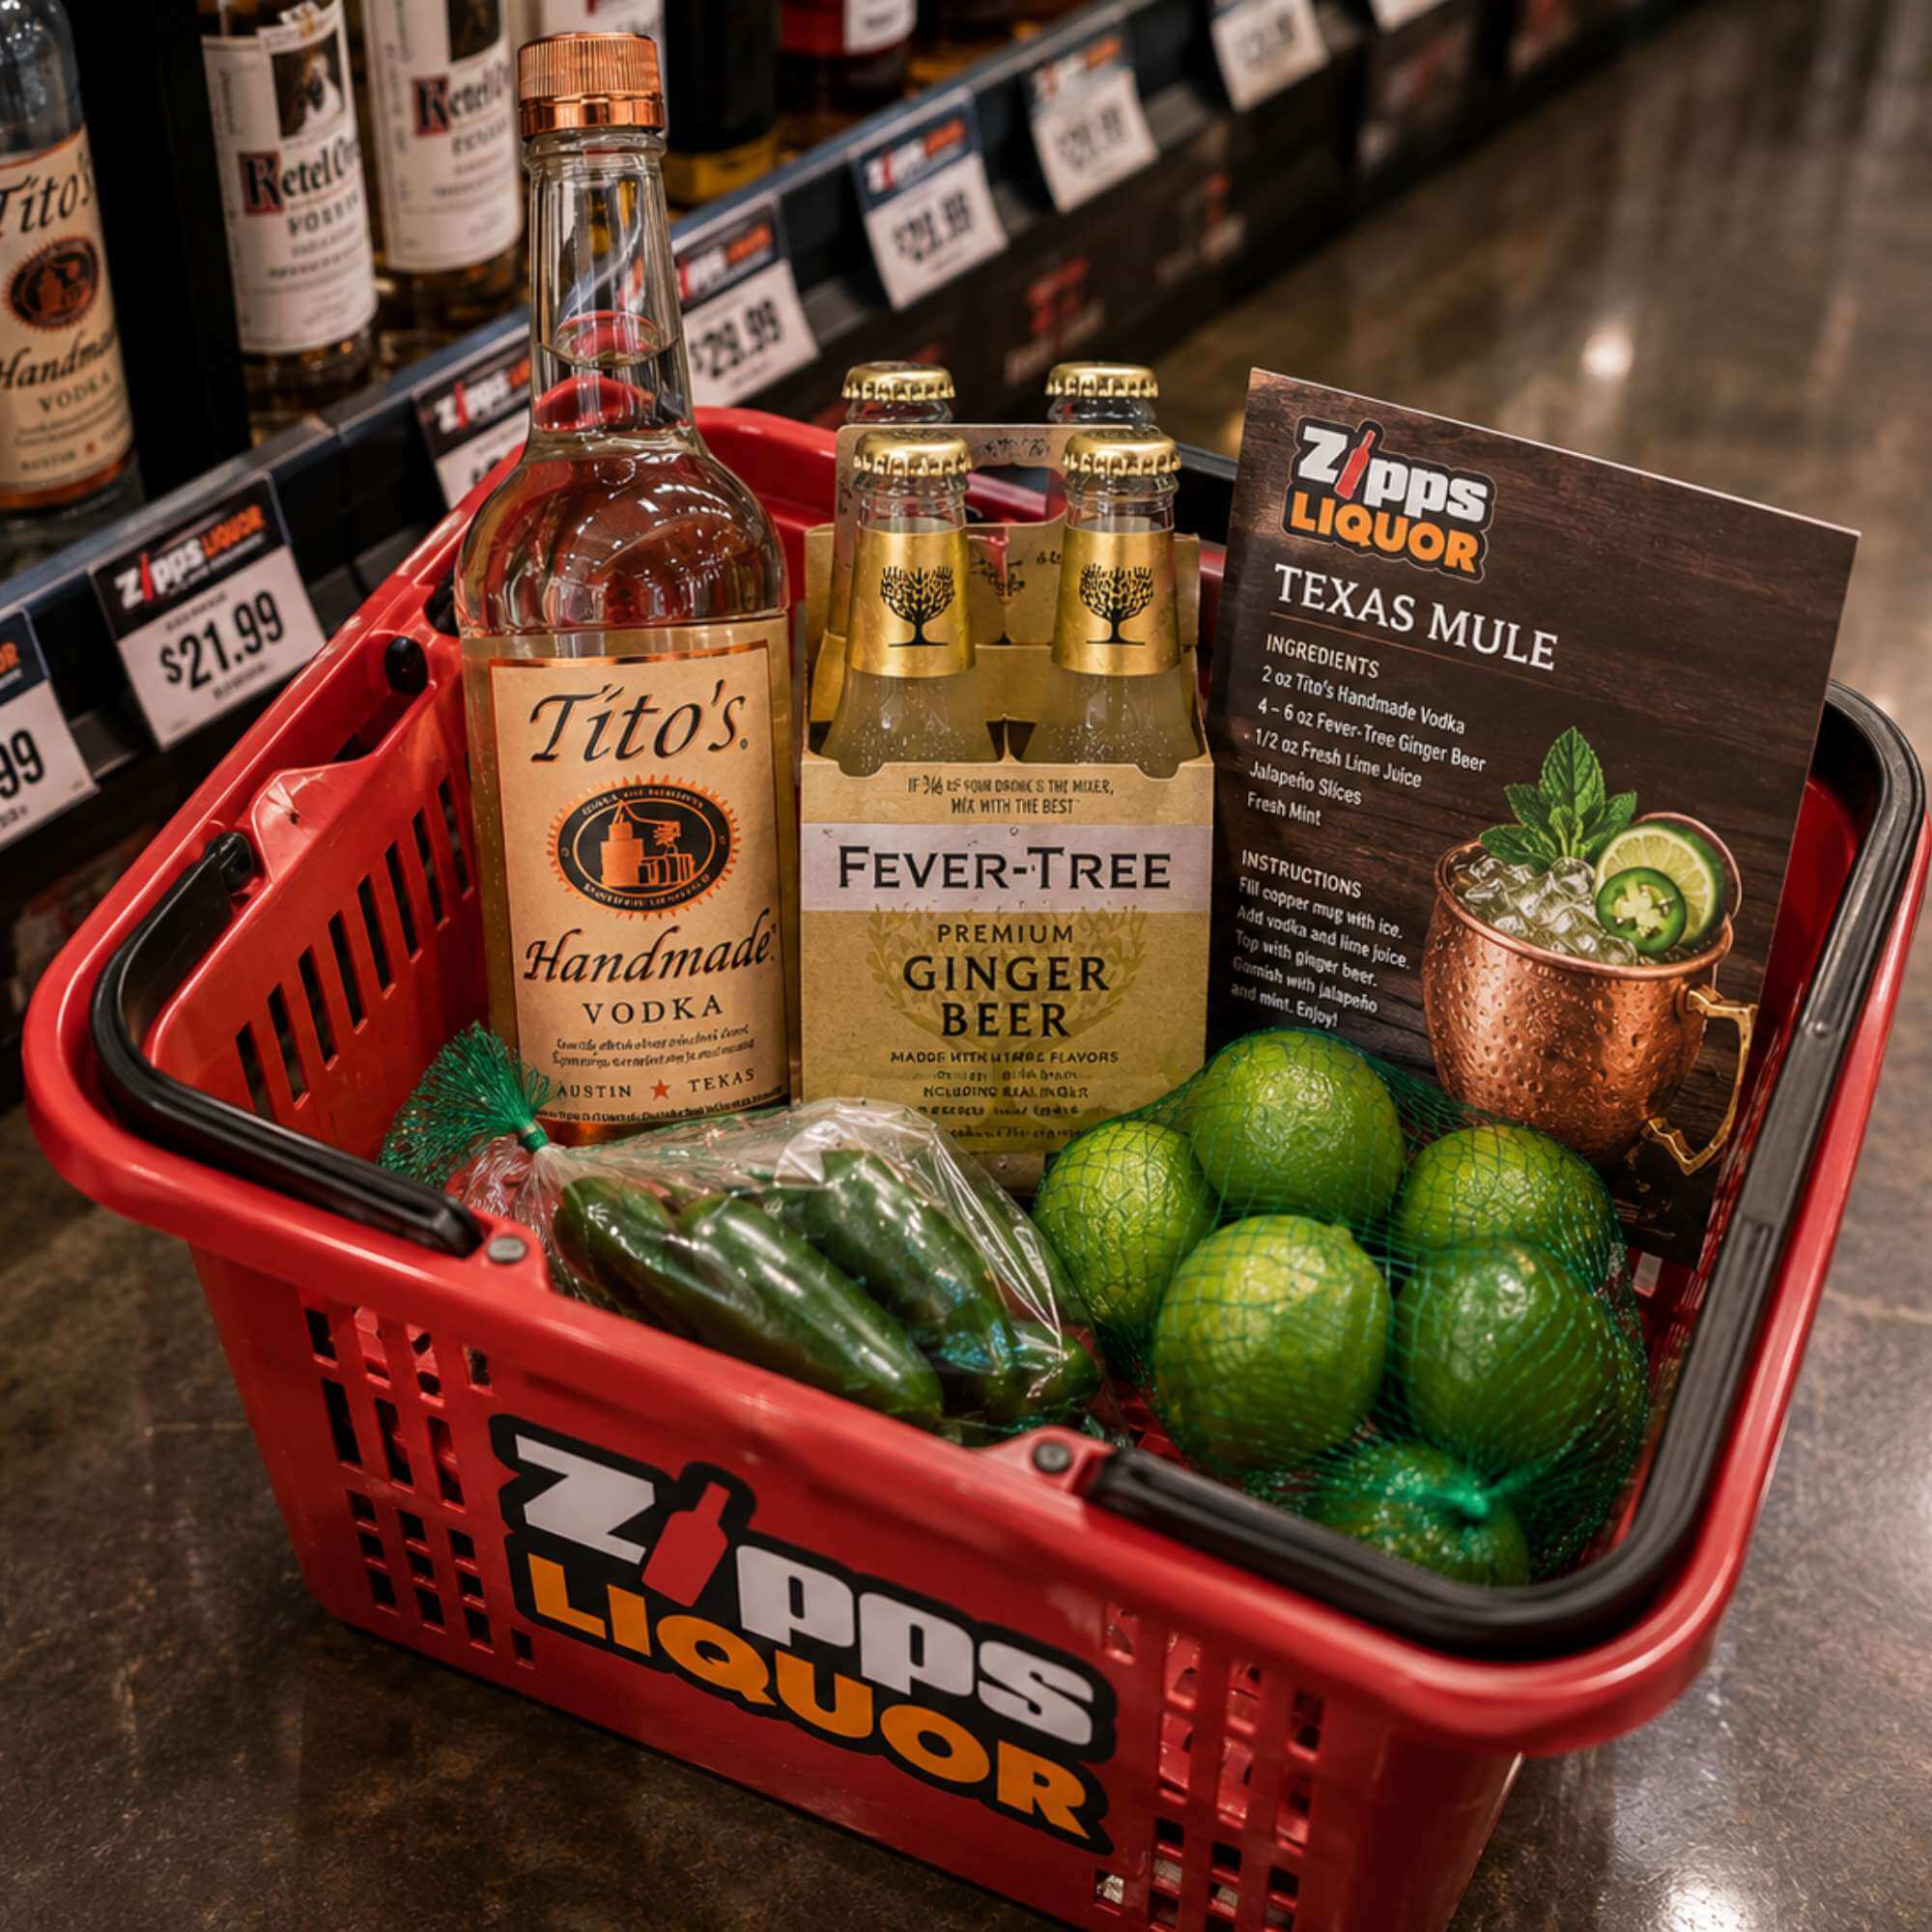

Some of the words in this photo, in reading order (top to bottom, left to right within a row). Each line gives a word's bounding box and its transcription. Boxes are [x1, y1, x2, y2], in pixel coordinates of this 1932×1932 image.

[1297, 425, 1488, 523] Zipps
[1290, 491, 1479, 573] LIQUOR
[114, 538, 204, 610] Zipps
[160, 590, 283, 690] $21.99
[1275, 563, 1415, 633] TEXAS
[1427, 602, 1558, 671] MULE
[1265, 634, 1379, 678] INGREDIENTS
[530, 679, 746, 763] Tito's
[1262, 665, 1272, 683] 2
[1274, 672, 1292, 688] oz
[1296, 673, 1334, 698] Tito's
[1337, 684, 1417, 722] Handmade
[1421, 706, 1465, 734] Vodka
[1256, 728, 1279, 750] 1/2
[1281, 739, 1298, 755] oz
[1301, 741, 1341, 767] Fresh
[1345, 753, 1380, 777] Lime
[1382, 762, 1422, 788] Juice
[1258, 697, 1268, 715] 4
[1284, 703, 1293, 722] 6
[1296, 710, 1313, 726] oz
[1317, 712, 1395, 748] Fever-Tree
[1399, 734, 1447, 762] Ginger
[1451, 747, 1487, 772] Beer
[952, 797, 976, 814] MIX
[980, 798, 1011, 814] WITH
[1015, 798, 1038, 814] THE
[1042, 798, 1075, 814] BEST
[1247, 791, 1286, 816] Fresh
[1289, 801, 1321, 826] Mint
[1249, 761, 1315, 792] Jalapeño
[1319, 778, 1362, 806] Slices
[838, 845, 1172, 890] FEVER-TREE
[1241, 849, 1362, 899] INSTRUCTIONS
[937, 923, 1074, 945] PREMIUM
[1238, 876, 1260, 896] Fill
[1262, 887, 1309, 911] copper
[1312, 903, 1344, 925] mug
[1347, 910, 1376, 932] with
[1378, 919, 1403, 939] ice.
[523, 908, 774, 982] Handmade
[1235, 929, 1259, 952] Top
[1263, 939, 1292, 960] with
[1295, 950, 1339, 975] ginger
[1342, 962, 1378, 987] beer.
[1236, 905, 1264, 926] Add
[1266, 916, 1307, 938] vodka
[1310, 927, 1337, 947] and
[1340, 933, 1370, 957] lime
[1372, 944, 1410, 970] juice.
[902, 955, 1110, 992] GINGER
[1287, 973, 1315, 994] with
[582, 994, 724, 1025] VODKA
[942, 1003, 1071, 1037] BEER
[1231, 982, 1257, 1002] and
[1260, 991, 1294, 1014] mint.
[1296, 1000, 1338, 1030] Enjoy!
[556, 1082, 632, 1099] AUSTIN
[688, 1068, 755, 1094] TEXAS
[1050, 1051, 1120, 1064] FLAVORS
[515, 1434, 1094, 1746] Zipps
[527, 1552, 1092, 1839] LIQUOR
